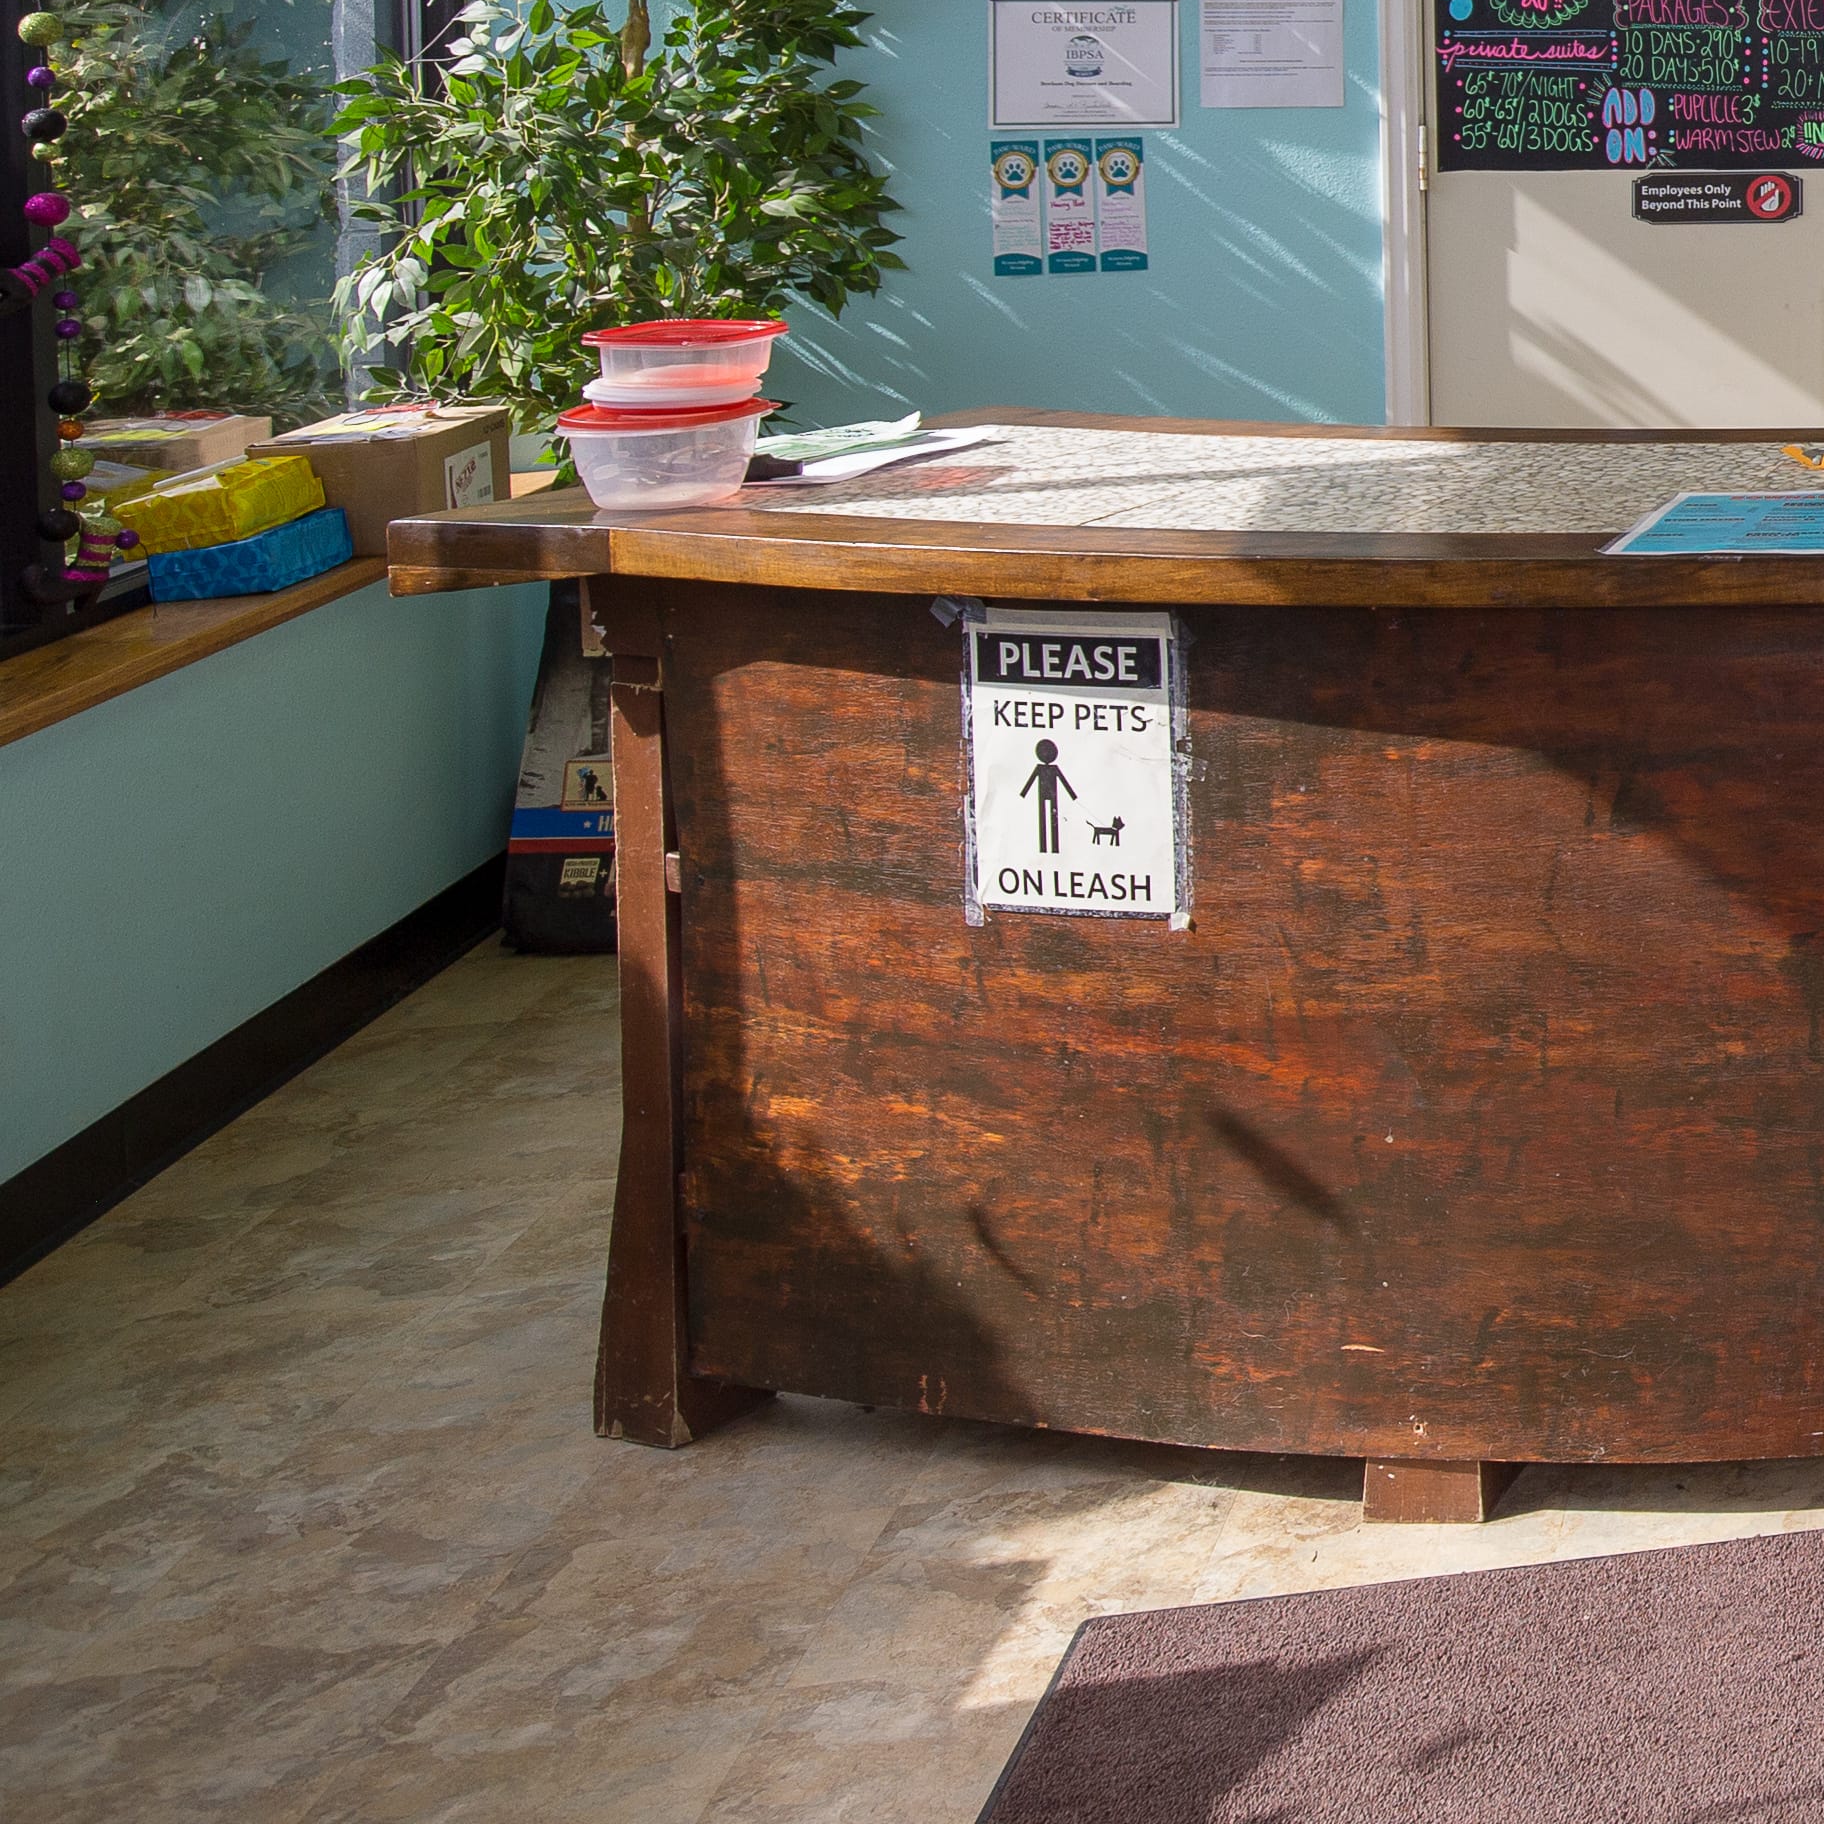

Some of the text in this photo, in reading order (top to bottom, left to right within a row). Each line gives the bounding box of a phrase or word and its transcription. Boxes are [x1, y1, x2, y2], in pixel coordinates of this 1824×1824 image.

[1031, 11, 1136, 24] CERTIFICATE
[1624, 32, 1643, 54] 10
[1066, 49, 1104, 59] IBPSA
[1620, 54, 1644, 78] 20
[1642, 185, 1731, 196] Employees Only
[1642, 199, 1742, 211] Beyond This Point
[999, 641, 1139, 681] PLEASE
[994, 700, 1147, 733] KEEP PETS
[564, 867, 595, 878] KIBBLE
[999, 868, 1152, 902] ON LEASH
